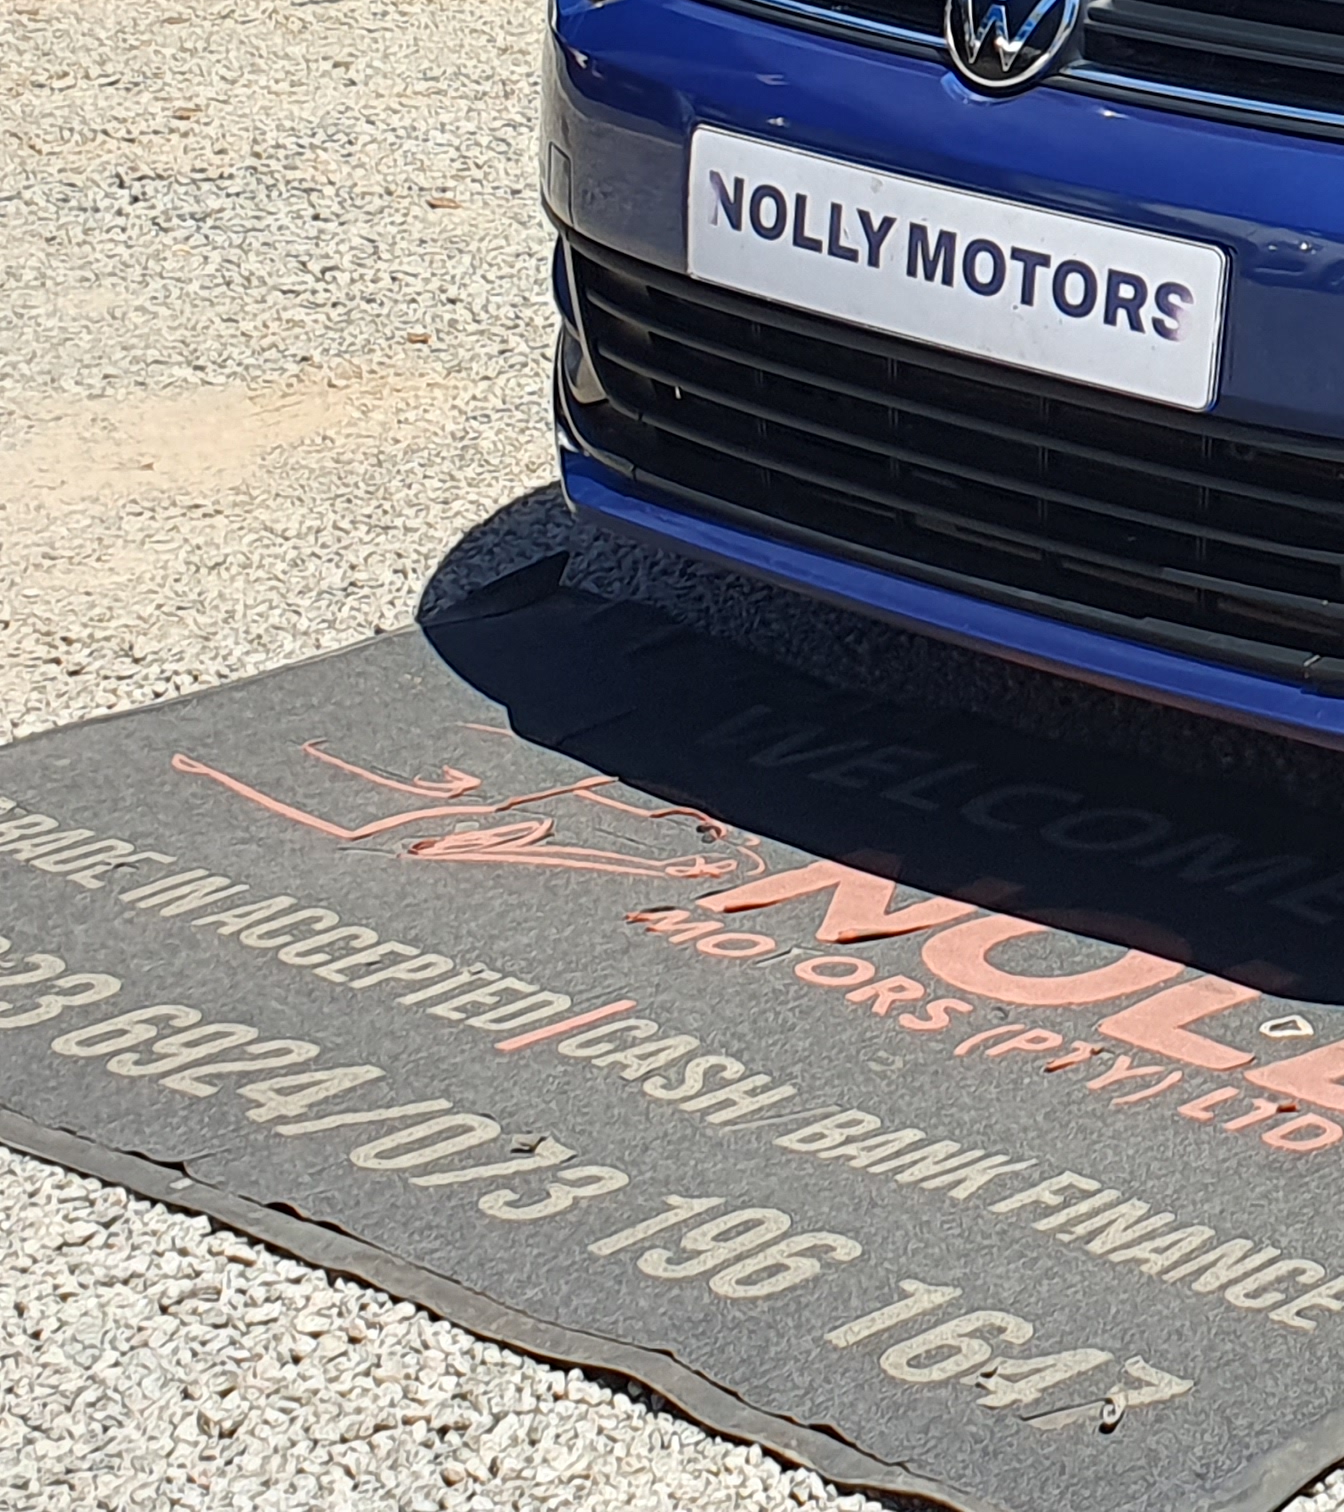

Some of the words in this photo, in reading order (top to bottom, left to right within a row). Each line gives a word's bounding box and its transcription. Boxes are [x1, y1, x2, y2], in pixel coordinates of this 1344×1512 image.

[708, 170, 897, 270] NOLLY
[905, 222, 1195, 343] MOTORS
[0, 795, 178, 890] RADE
[118, 868, 250, 917] IN
[952, 1024, 1182, 1105] (PTY)
[1177, 1086, 1344, 1151] LTD
[50, 1004, 630, 1220] 6924/073
[586, 1193, 863, 1299] 196
[824, 1279, 1195, 1438] 1647
